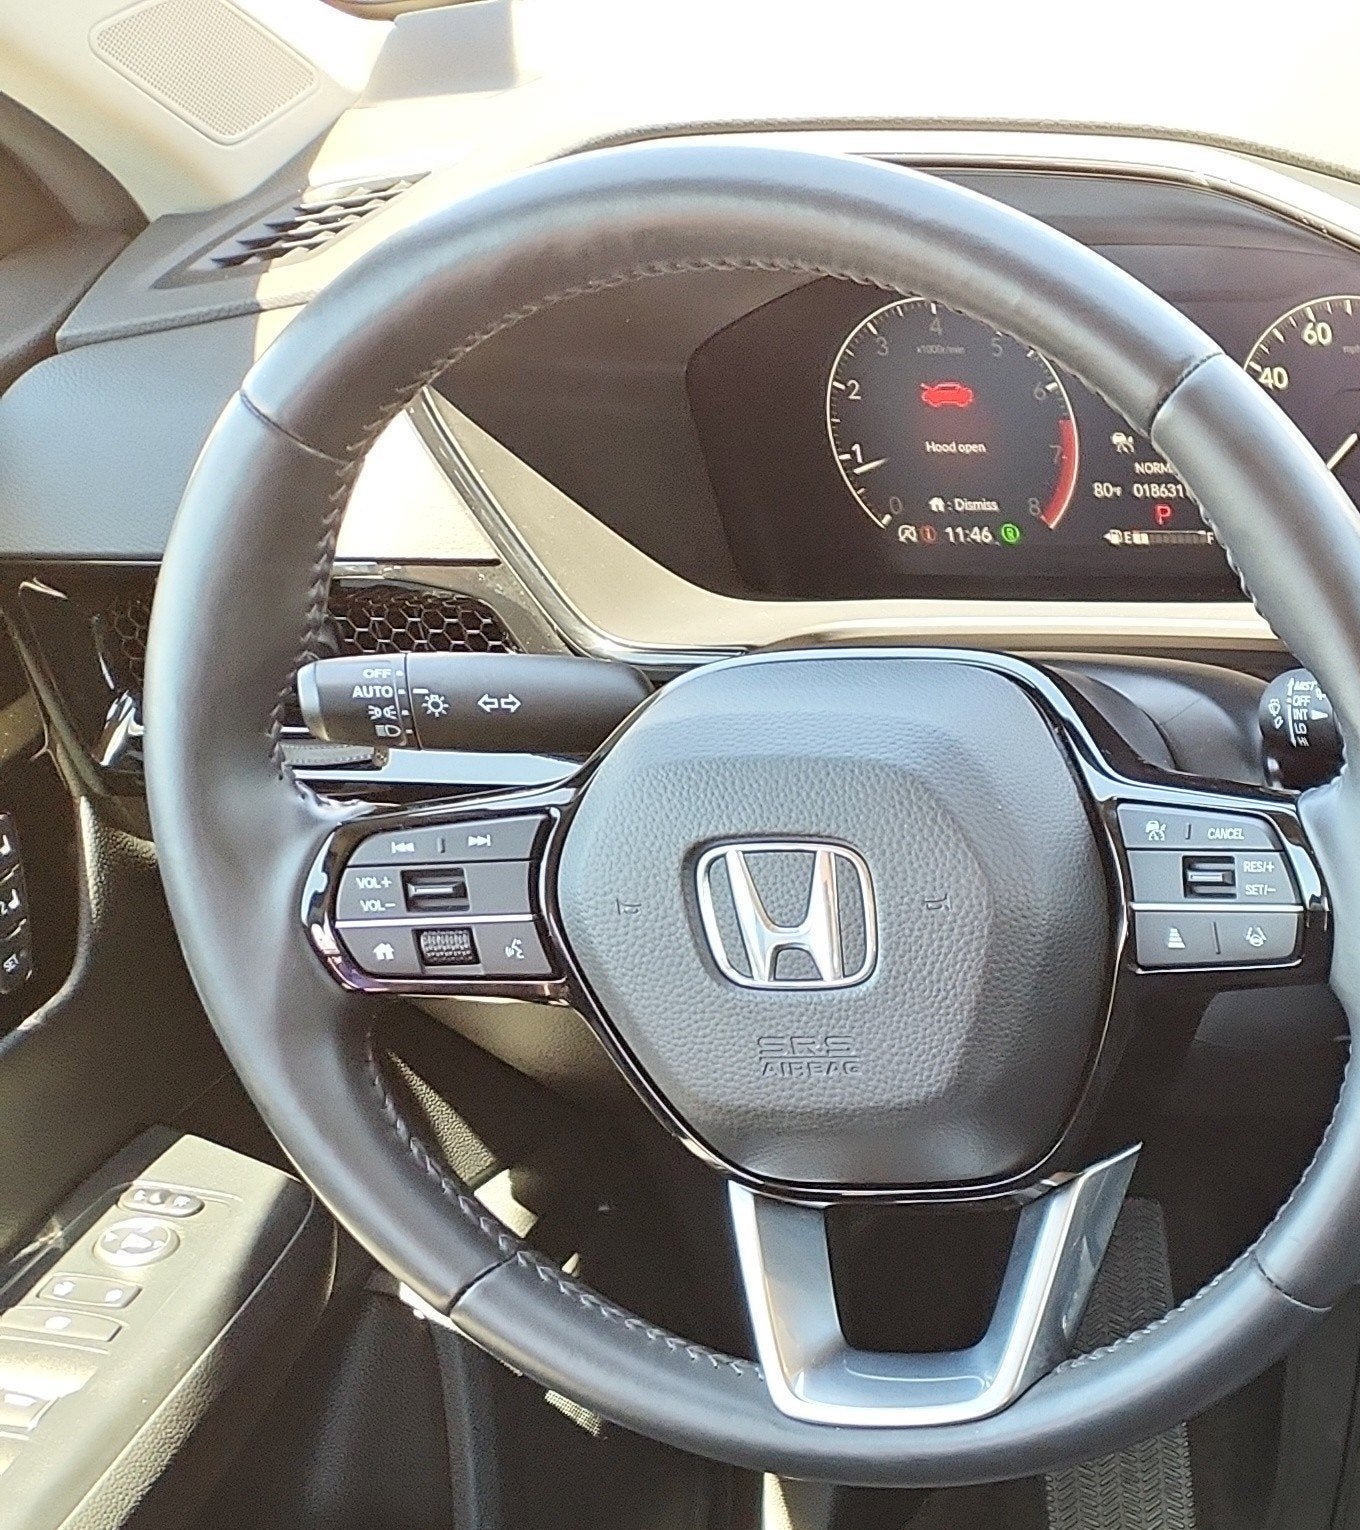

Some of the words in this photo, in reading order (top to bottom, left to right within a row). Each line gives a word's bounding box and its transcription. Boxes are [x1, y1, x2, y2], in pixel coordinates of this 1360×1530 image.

[930, 317, 942, 335] 4
[1303, 323, 1333, 346] 60
[876, 337, 889, 356] 3
[1259, 367, 1289, 390] 40
[846, 380, 861, 400] 2
[852, 443, 862, 463] 1
[925, 441, 956, 453] Hood
[957, 443, 986, 454] open
[1134, 462, 1174, 474] NORM
[954, 498, 998, 511] Dismiss
[1156, 505, 1171, 524] P
[945, 527, 993, 544] 11:46
[362, 668, 391, 679] OFF
[352, 685, 393, 699] AUTO
[1293, 695, 1311, 706] OFF
[1293, 708, 1308, 720] INT
[1208, 828, 1245, 840] CANCEL
